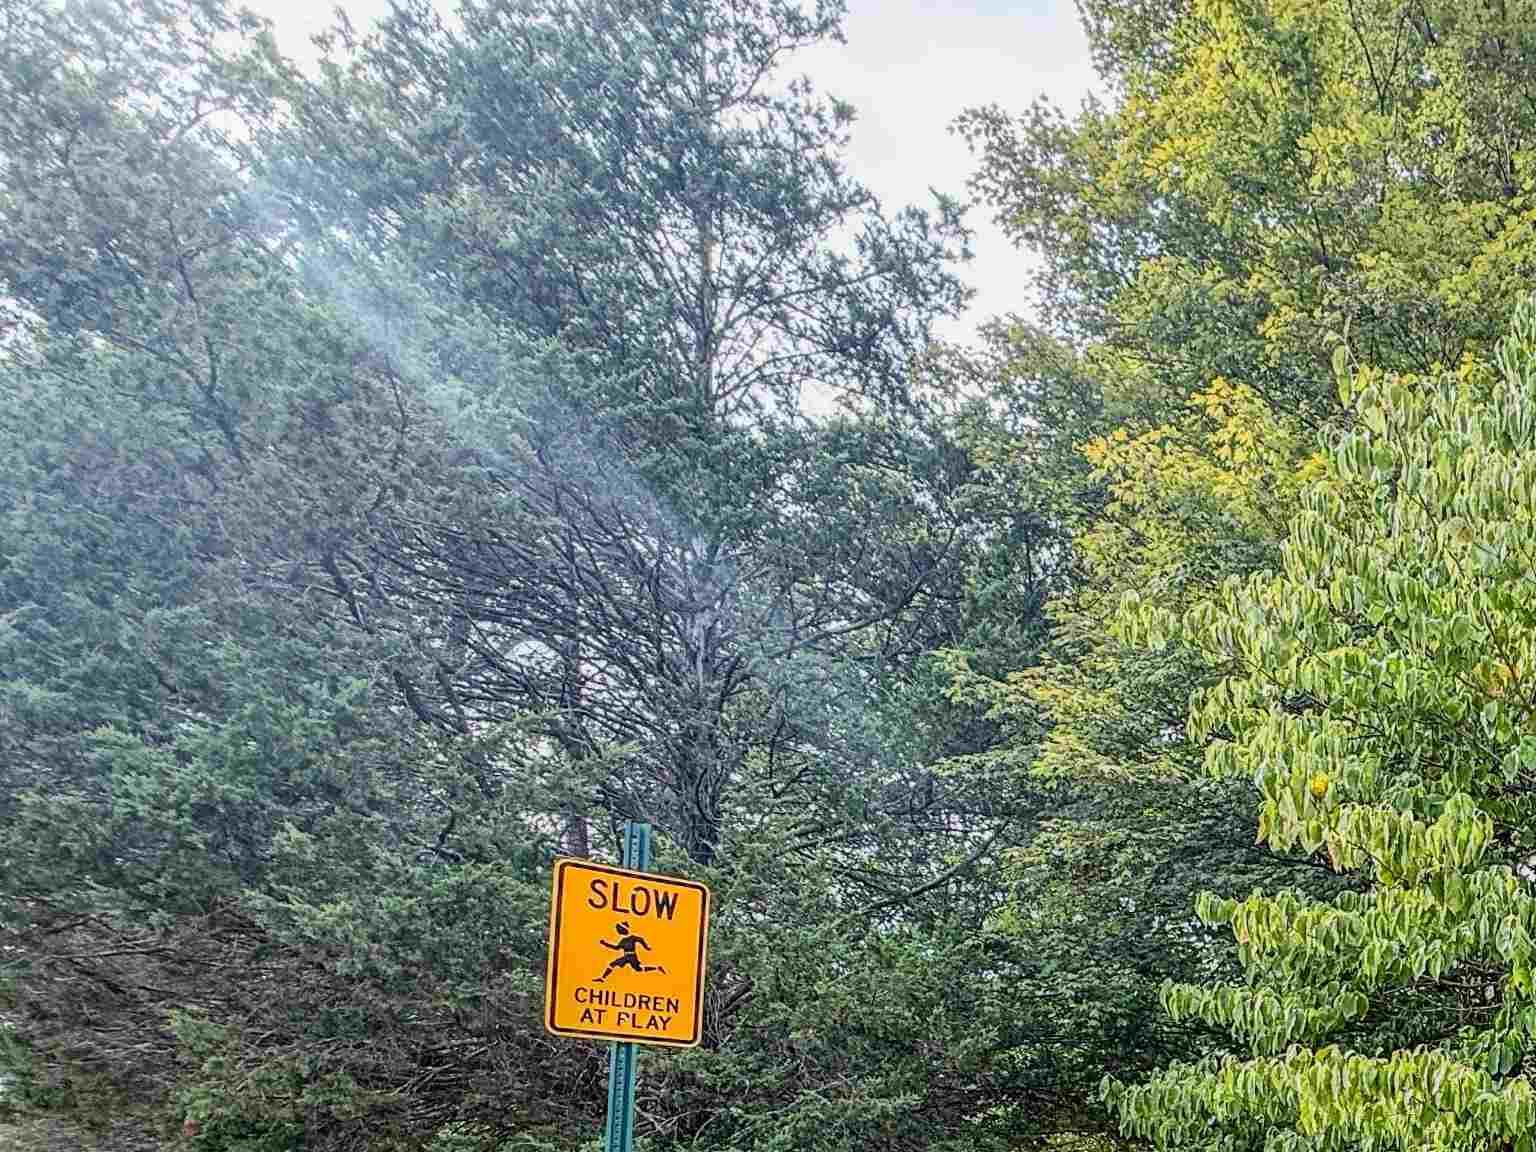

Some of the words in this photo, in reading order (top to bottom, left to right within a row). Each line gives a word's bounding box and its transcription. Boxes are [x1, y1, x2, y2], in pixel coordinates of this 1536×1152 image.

[588, 879, 679, 921] SLOW
[575, 987, 679, 1013] CHILDREN
[580, 1008, 606, 1025] AT
[617, 1011, 672, 1031] PLAY
